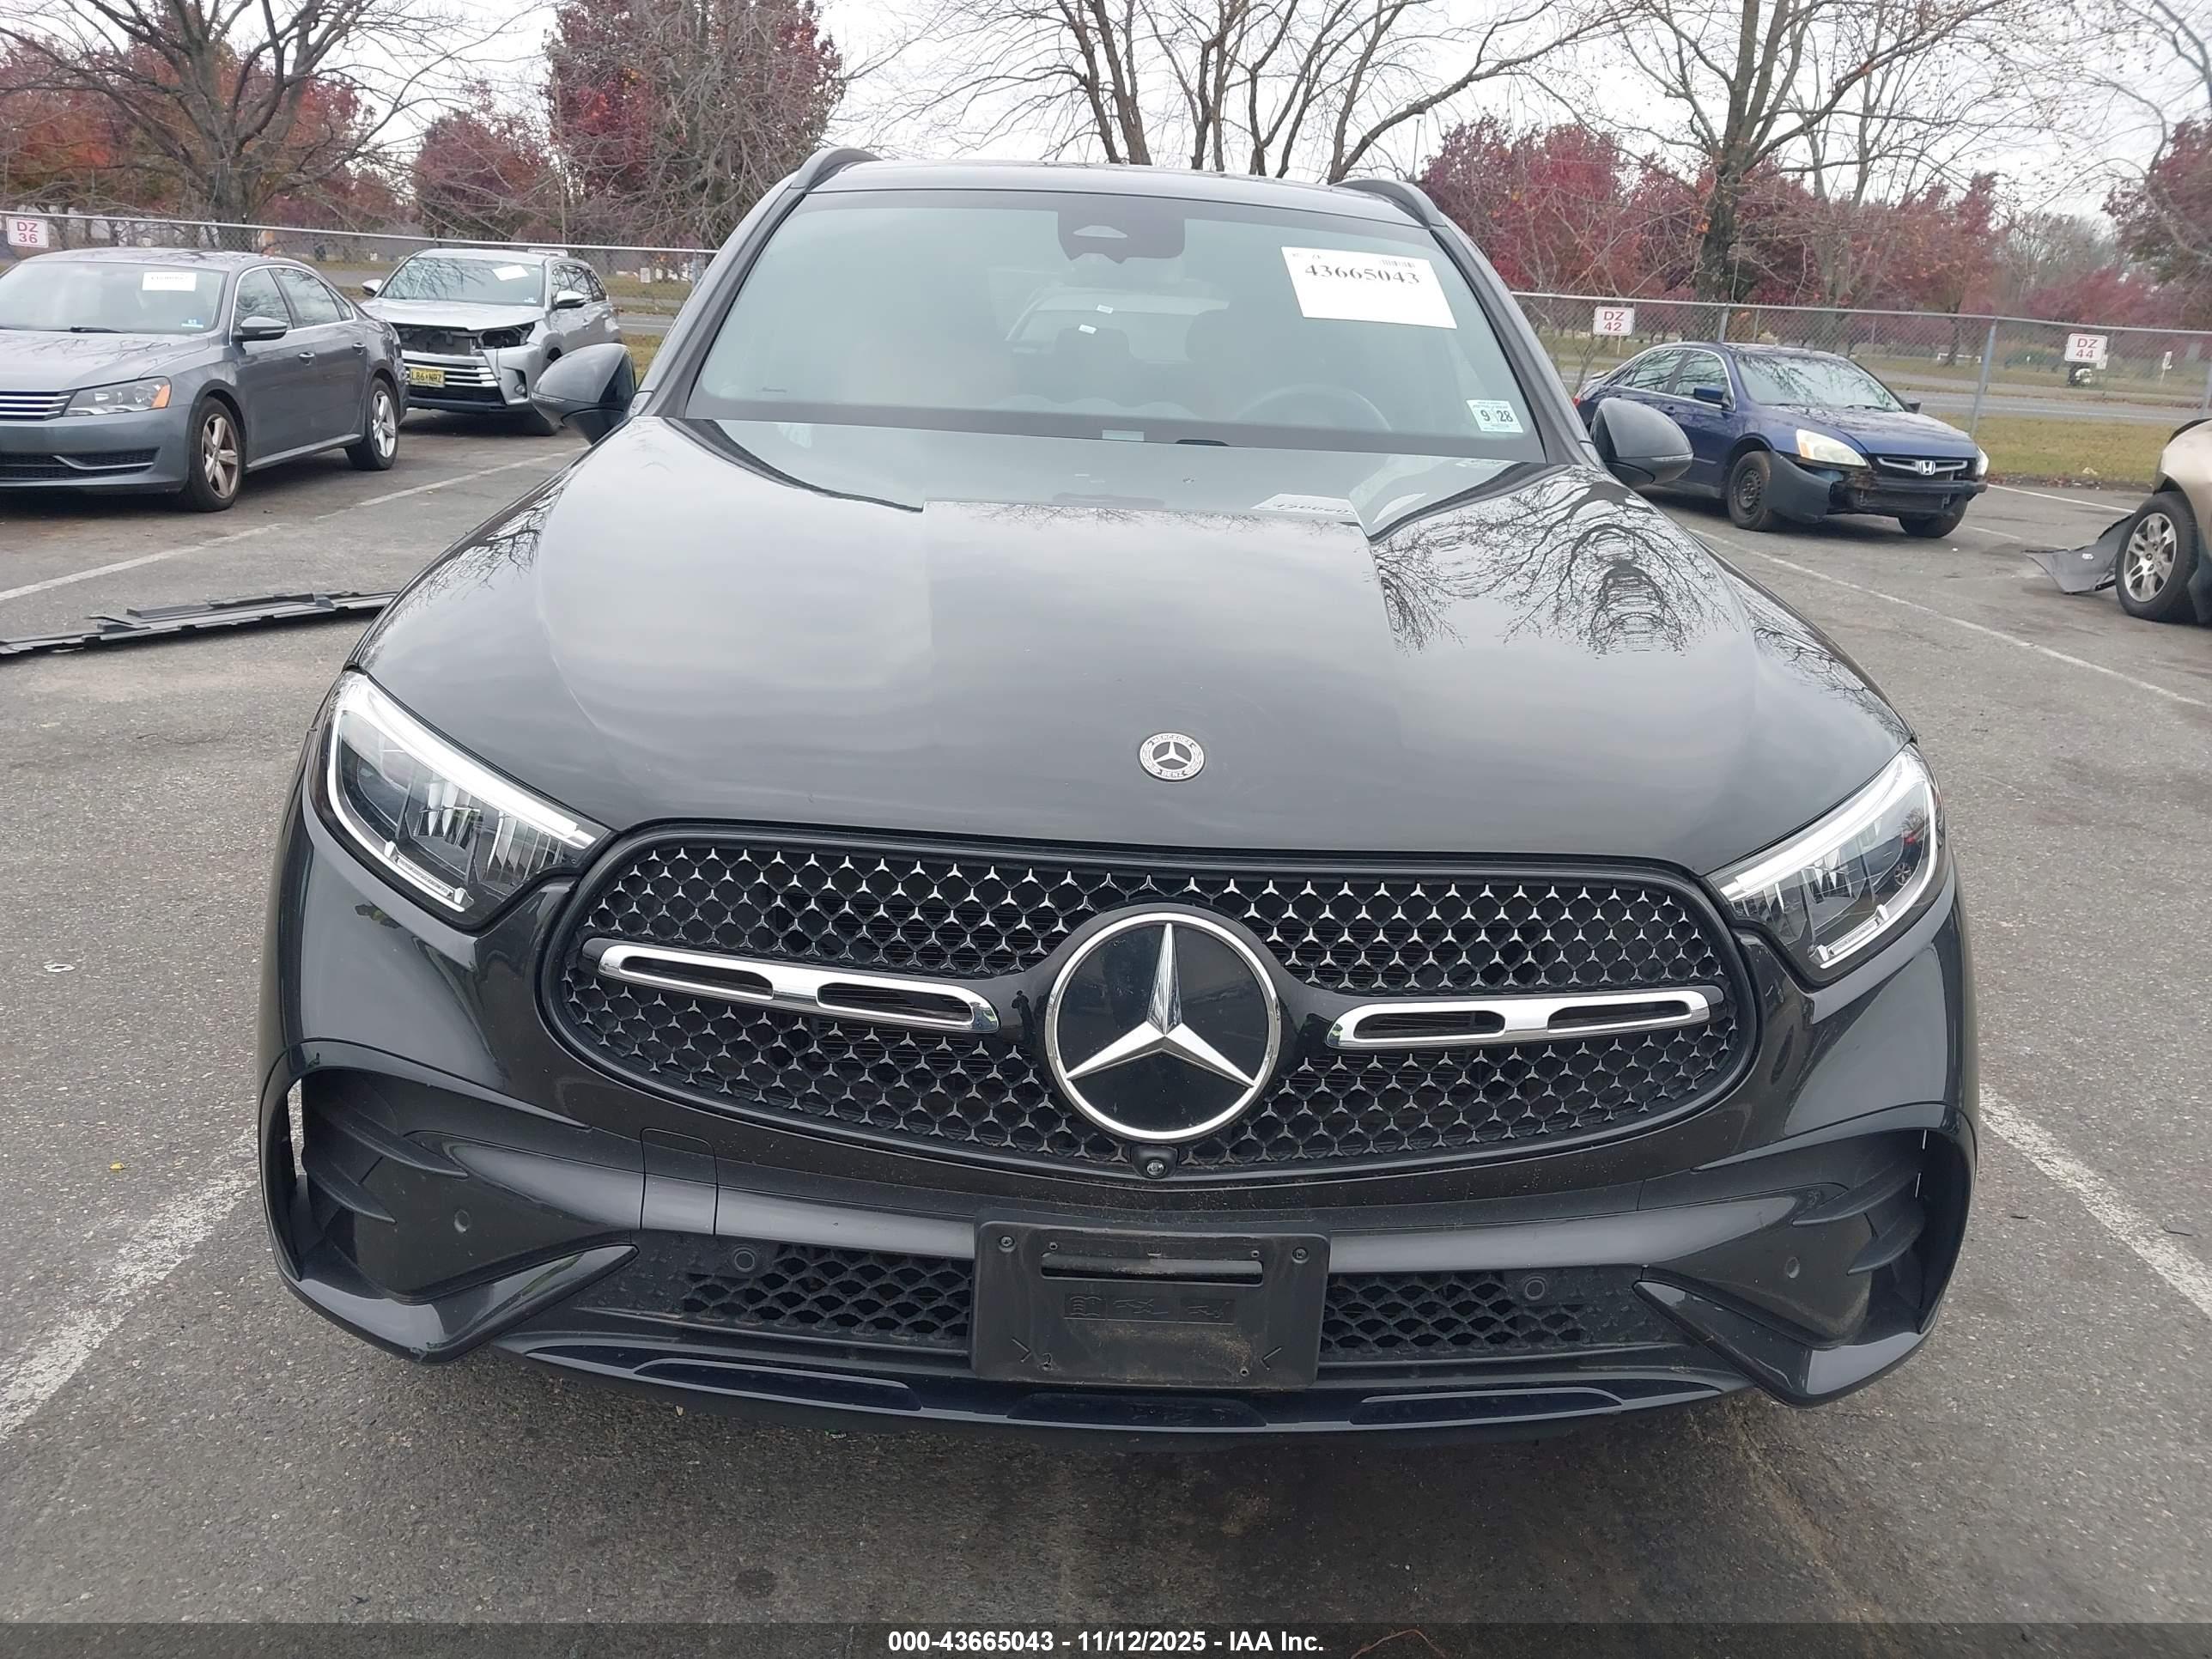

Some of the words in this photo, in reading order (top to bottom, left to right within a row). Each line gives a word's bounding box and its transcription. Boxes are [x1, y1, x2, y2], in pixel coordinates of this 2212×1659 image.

[17, 222, 38, 233] DZ
[19, 233, 38, 243] 36
[1304, 264, 1420, 284] 43665043
[1604, 311, 1625, 321] DZ
[1603, 321, 1622, 331] 42
[2077, 337, 2098, 349] DZ
[2075, 349, 2094, 359] 44
[1480, 410, 1491, 422] 9
[1496, 410, 1514, 422] 28
